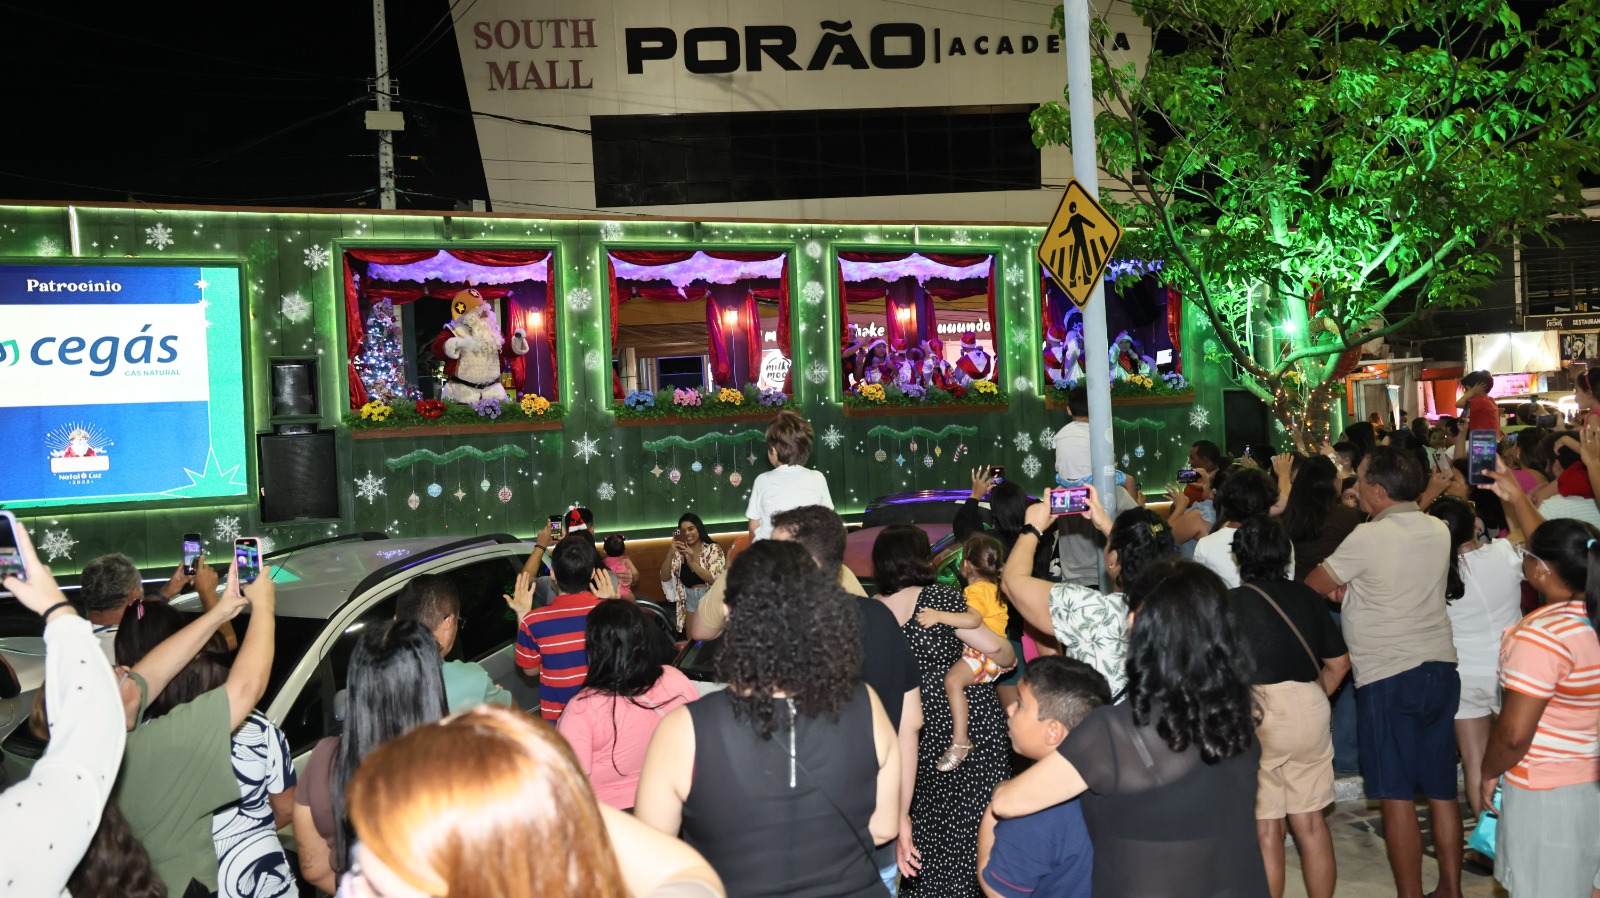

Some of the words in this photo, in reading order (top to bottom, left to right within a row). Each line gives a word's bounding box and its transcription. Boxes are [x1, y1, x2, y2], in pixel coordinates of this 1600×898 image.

[474, 18, 598, 50] SOUTH
[625, 20, 926, 74] PORÃO
[949, 33, 1131, 56] ACADEIA
[487, 59, 594, 92] MALL
[26, 279, 122, 292] Patrocínio
[854, 321, 885, 338] hake
[937, 318, 991, 334] uuundo
[30, 324, 179, 377] cegás
